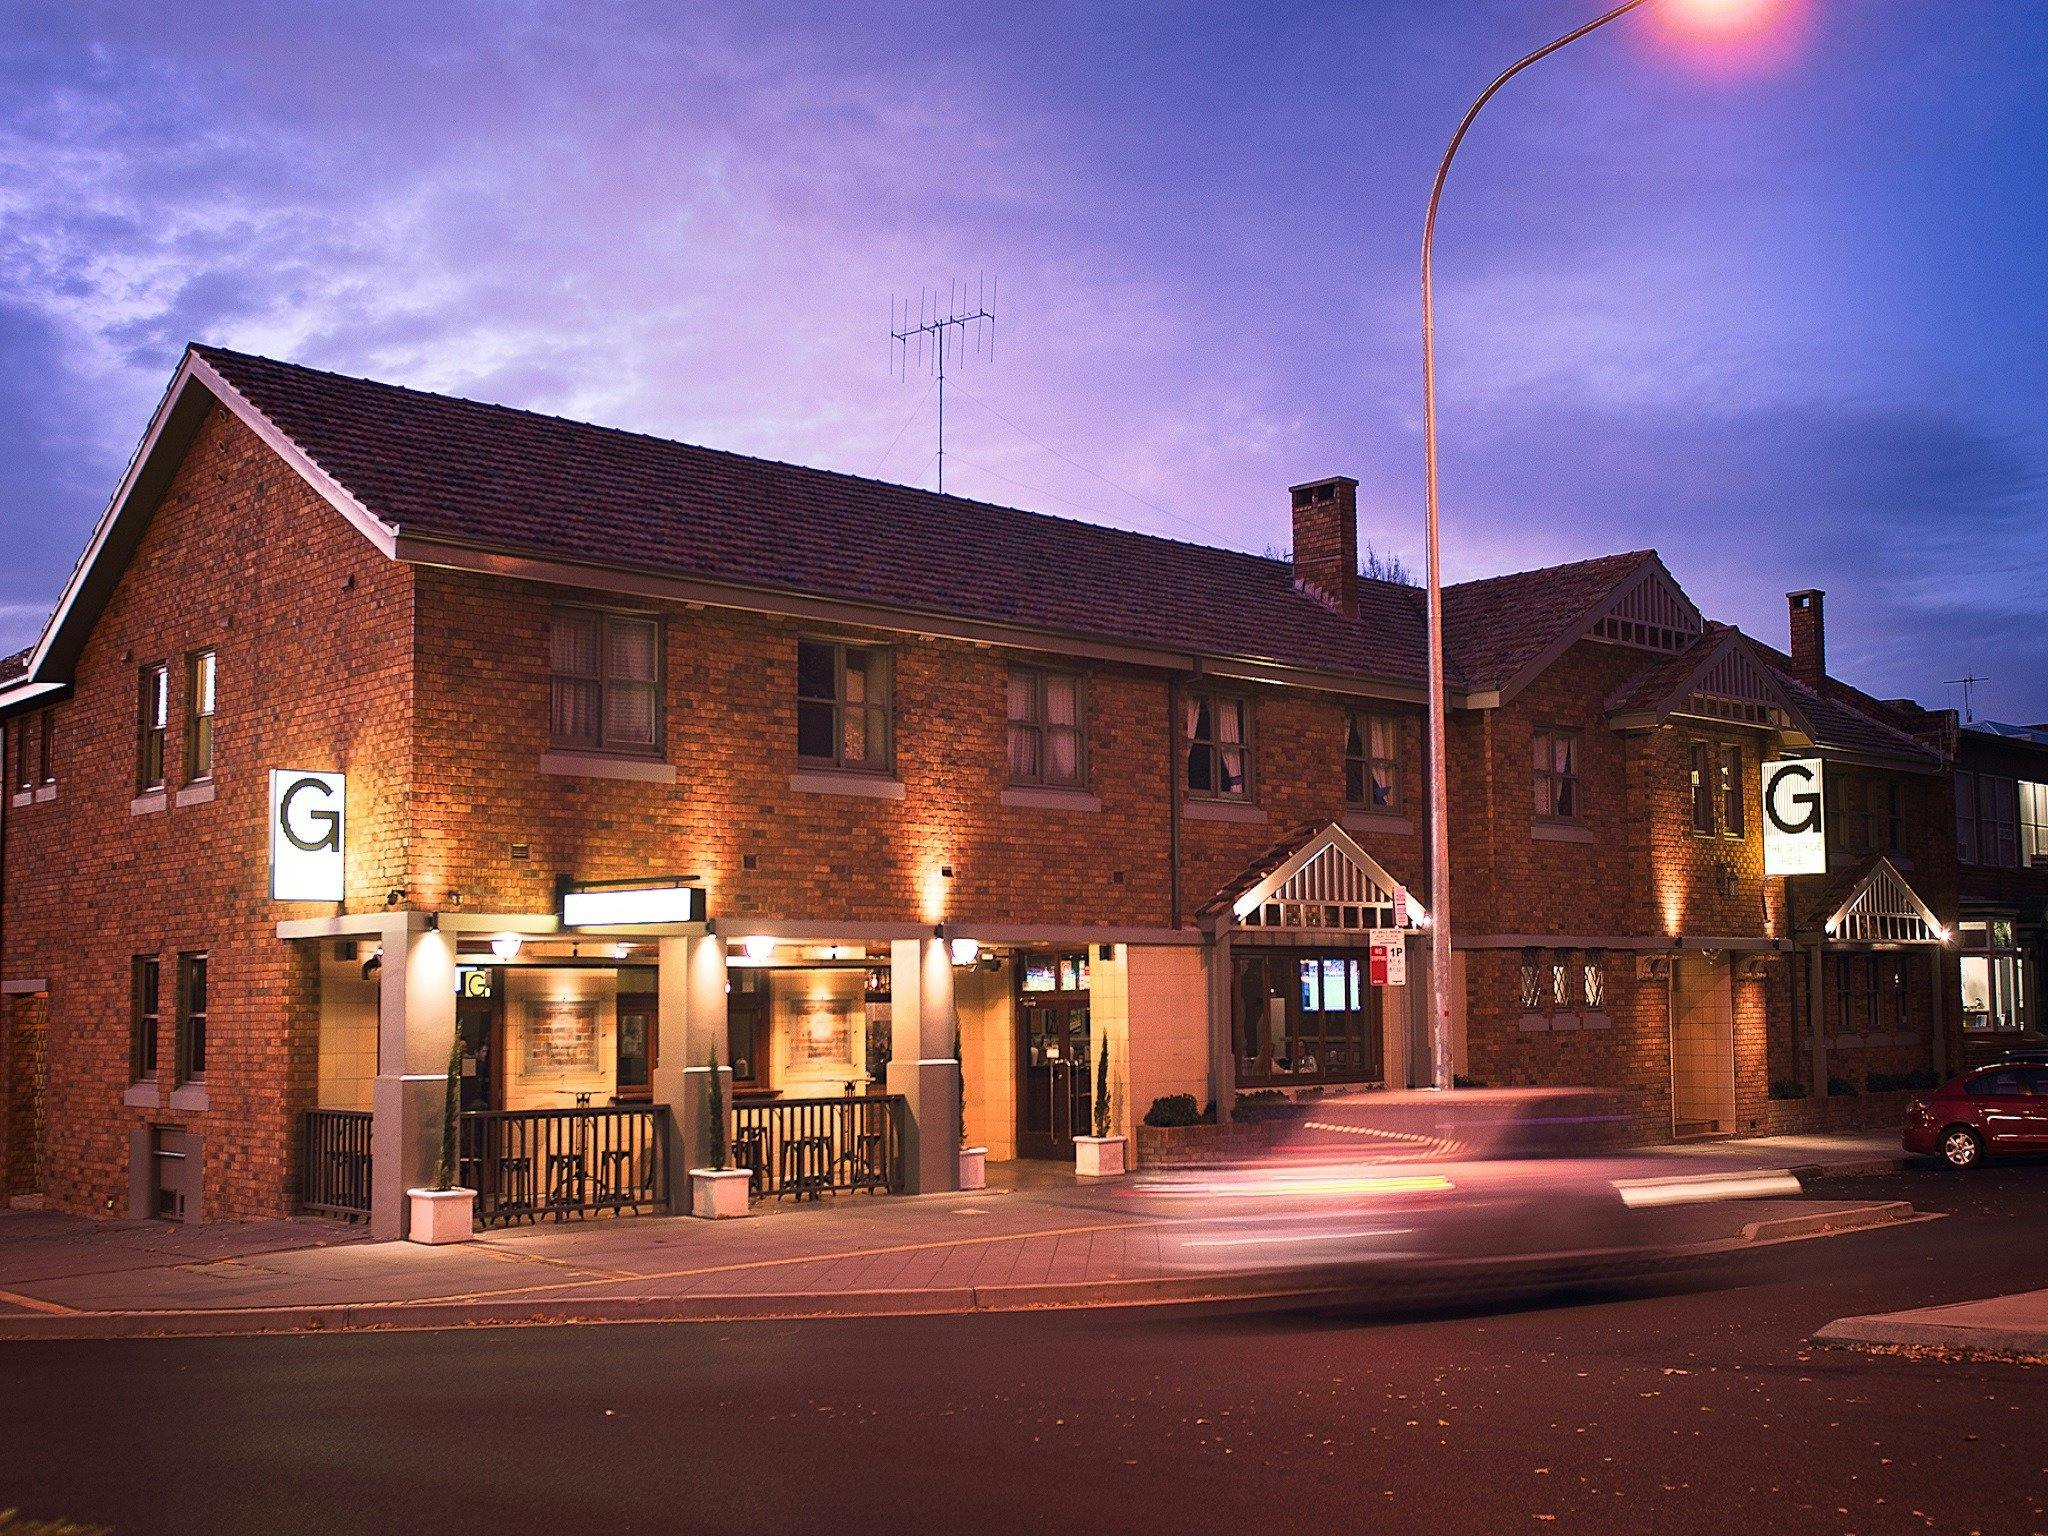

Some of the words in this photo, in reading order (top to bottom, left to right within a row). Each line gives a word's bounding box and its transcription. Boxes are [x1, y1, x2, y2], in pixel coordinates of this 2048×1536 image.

[281, 778, 339, 852] G
[1766, 765, 1821, 834] G
[1390, 947, 1403, 957] 1P
[469, 974, 486, 998] G
